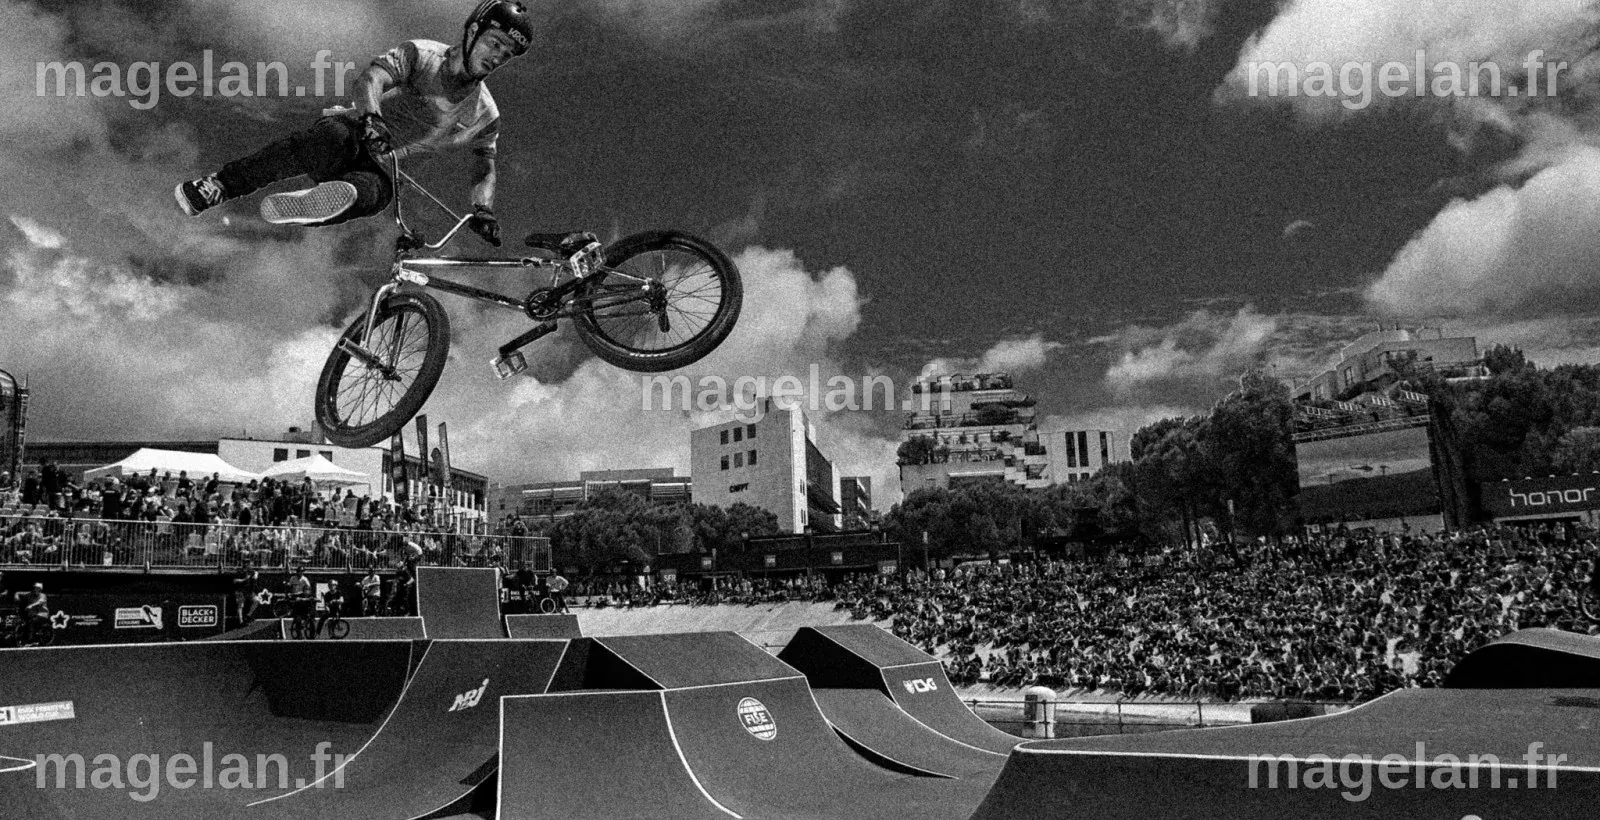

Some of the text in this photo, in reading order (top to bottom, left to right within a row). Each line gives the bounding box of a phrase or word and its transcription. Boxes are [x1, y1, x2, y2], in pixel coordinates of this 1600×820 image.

[1509, 488, 1596, 507] honor
[663, 574, 677, 582] SFR
[182, 616, 214, 624] DECKER
[448, 678, 489, 711] NRJ
